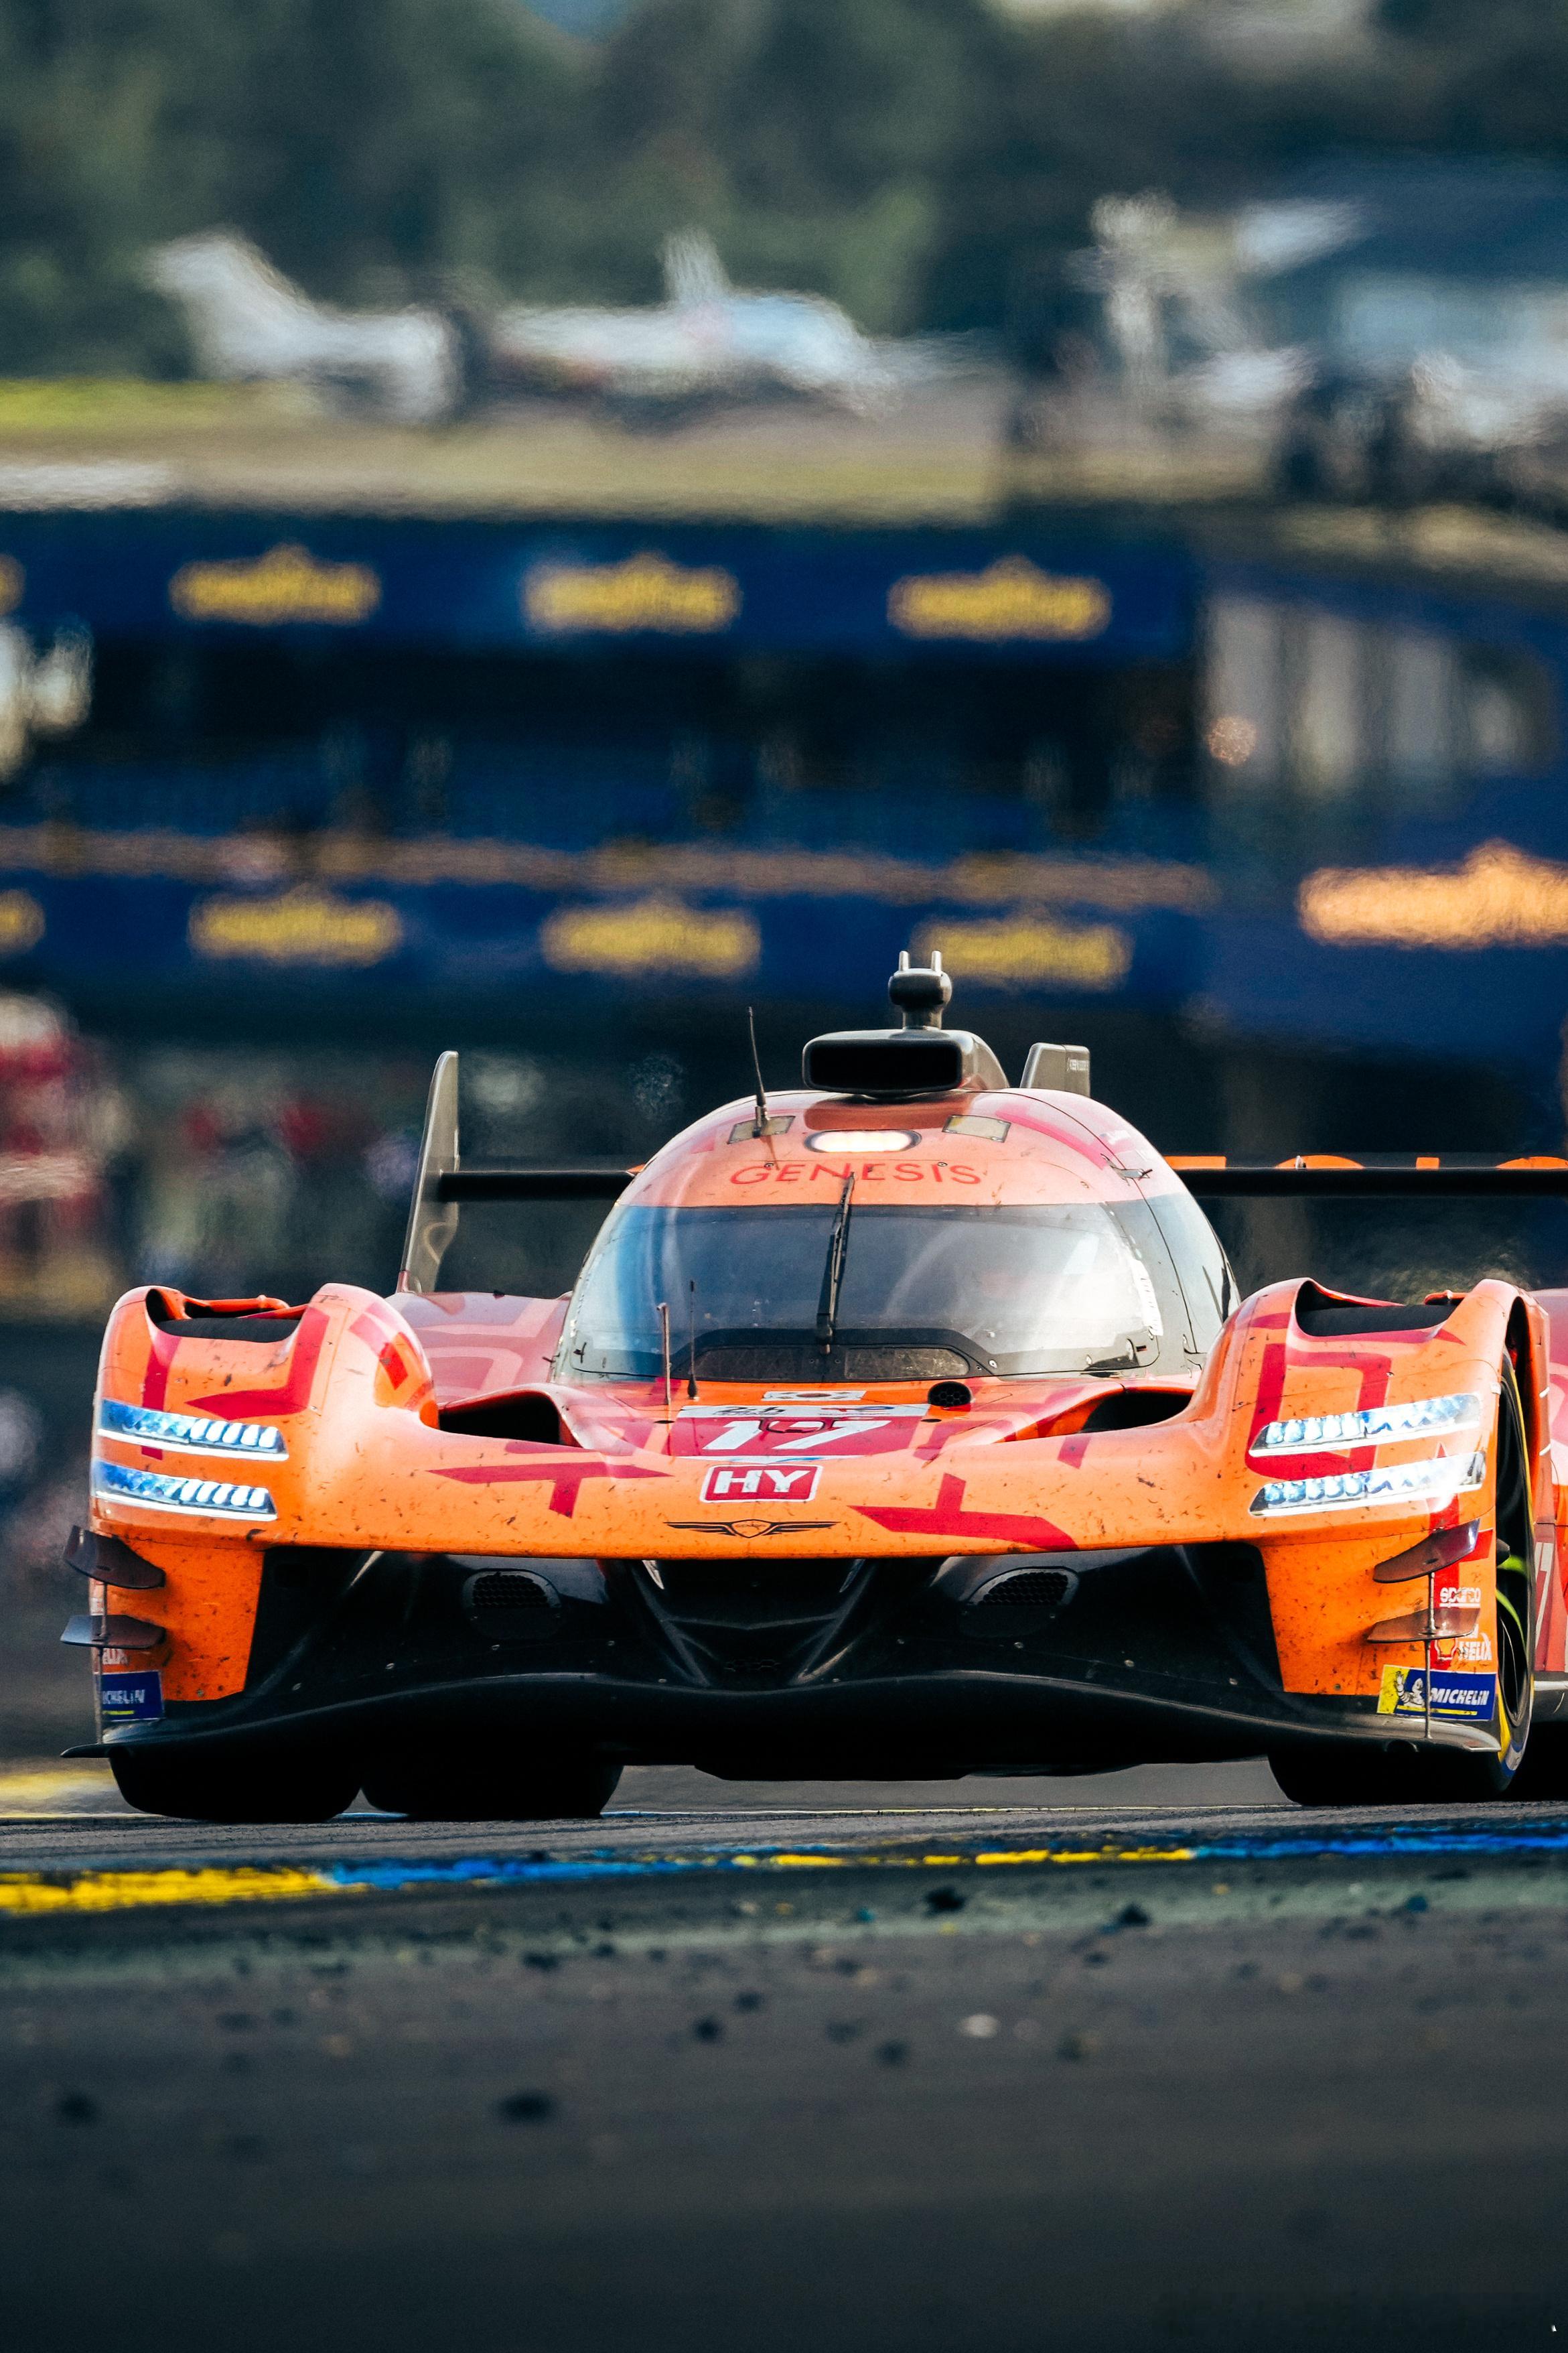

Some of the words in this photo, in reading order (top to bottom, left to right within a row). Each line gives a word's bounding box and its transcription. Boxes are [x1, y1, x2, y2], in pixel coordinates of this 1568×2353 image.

[730, 1162, 981, 1185] GENESIS
[702, 1420, 892, 1450] 17
[713, 1469, 810, 1493] HY
[1430, 1687, 1490, 1706] MICHELIN
